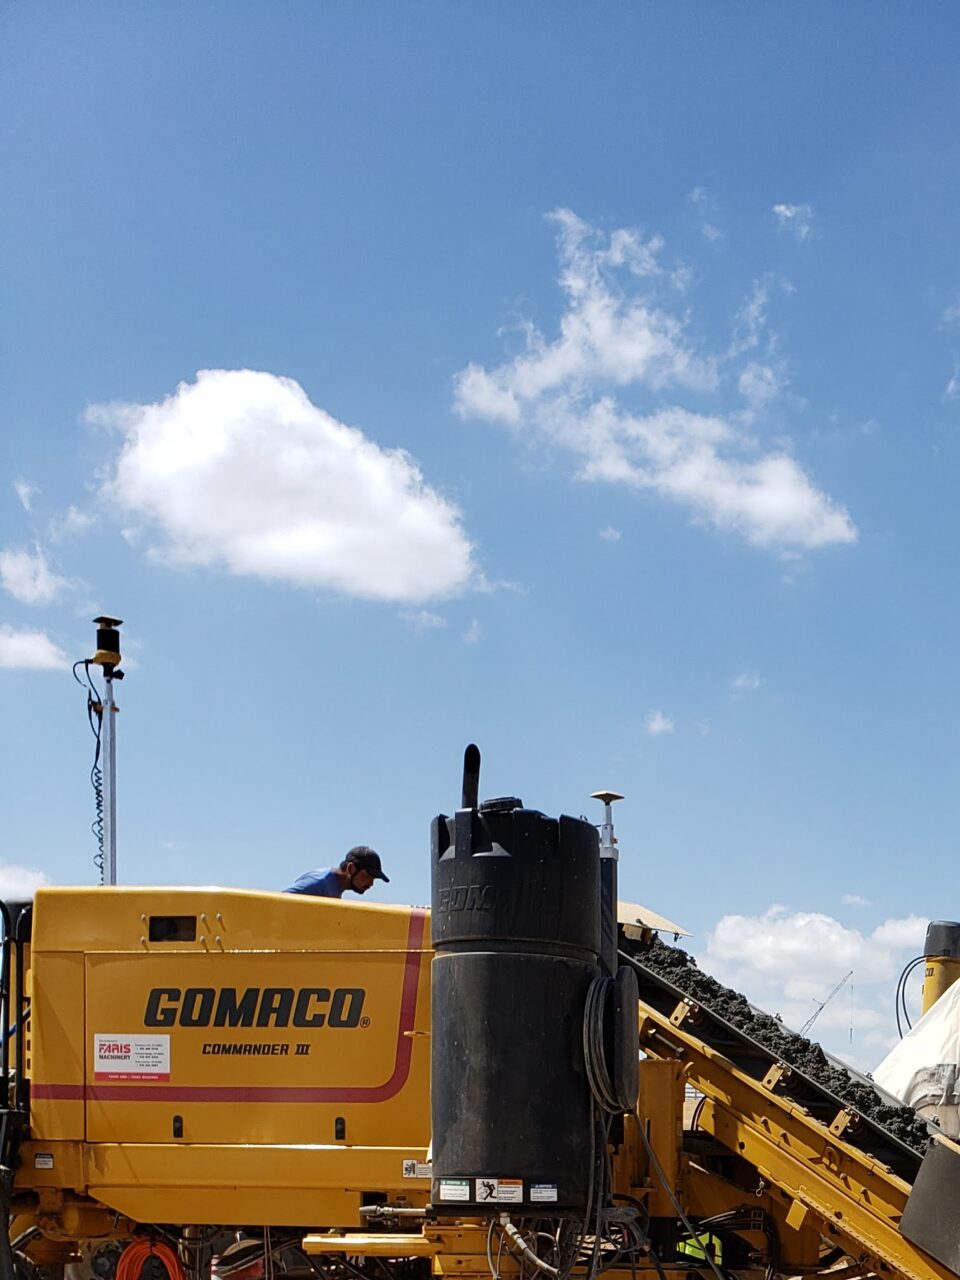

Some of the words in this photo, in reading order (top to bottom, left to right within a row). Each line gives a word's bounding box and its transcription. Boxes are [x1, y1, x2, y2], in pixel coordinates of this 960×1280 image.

[143, 987, 366, 1028] GOMACO
[98, 1043, 131, 1054] FARIS
[201, 1043, 290, 1056] COMMANDER
[294, 1043, 311, 1056] III
